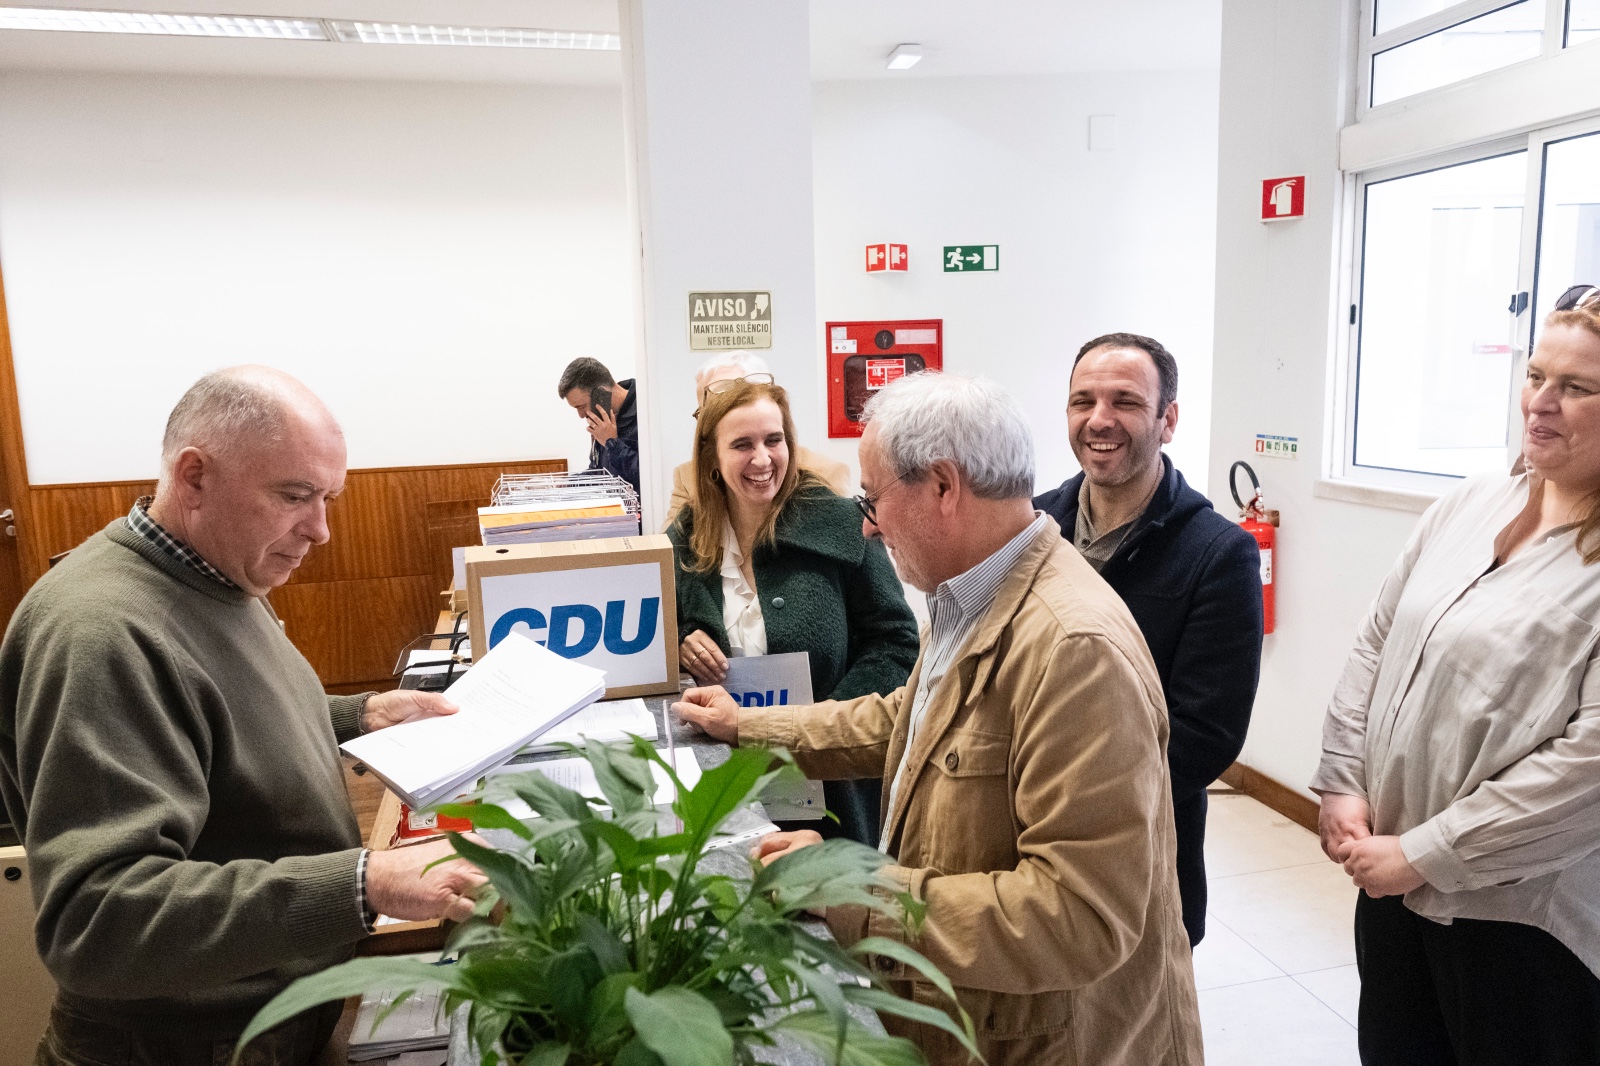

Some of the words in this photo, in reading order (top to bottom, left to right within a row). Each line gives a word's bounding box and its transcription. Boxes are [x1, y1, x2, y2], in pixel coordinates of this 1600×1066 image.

[693, 298, 747, 317] AVISO
[693, 323, 734, 334] MANTENHA
[736, 322, 769, 333] SILÊNCIO
[707, 336, 731, 346] NESTE
[732, 335, 756, 345] LOCAL
[489, 596, 660, 660] CDU
[729, 688, 788, 707] DU
